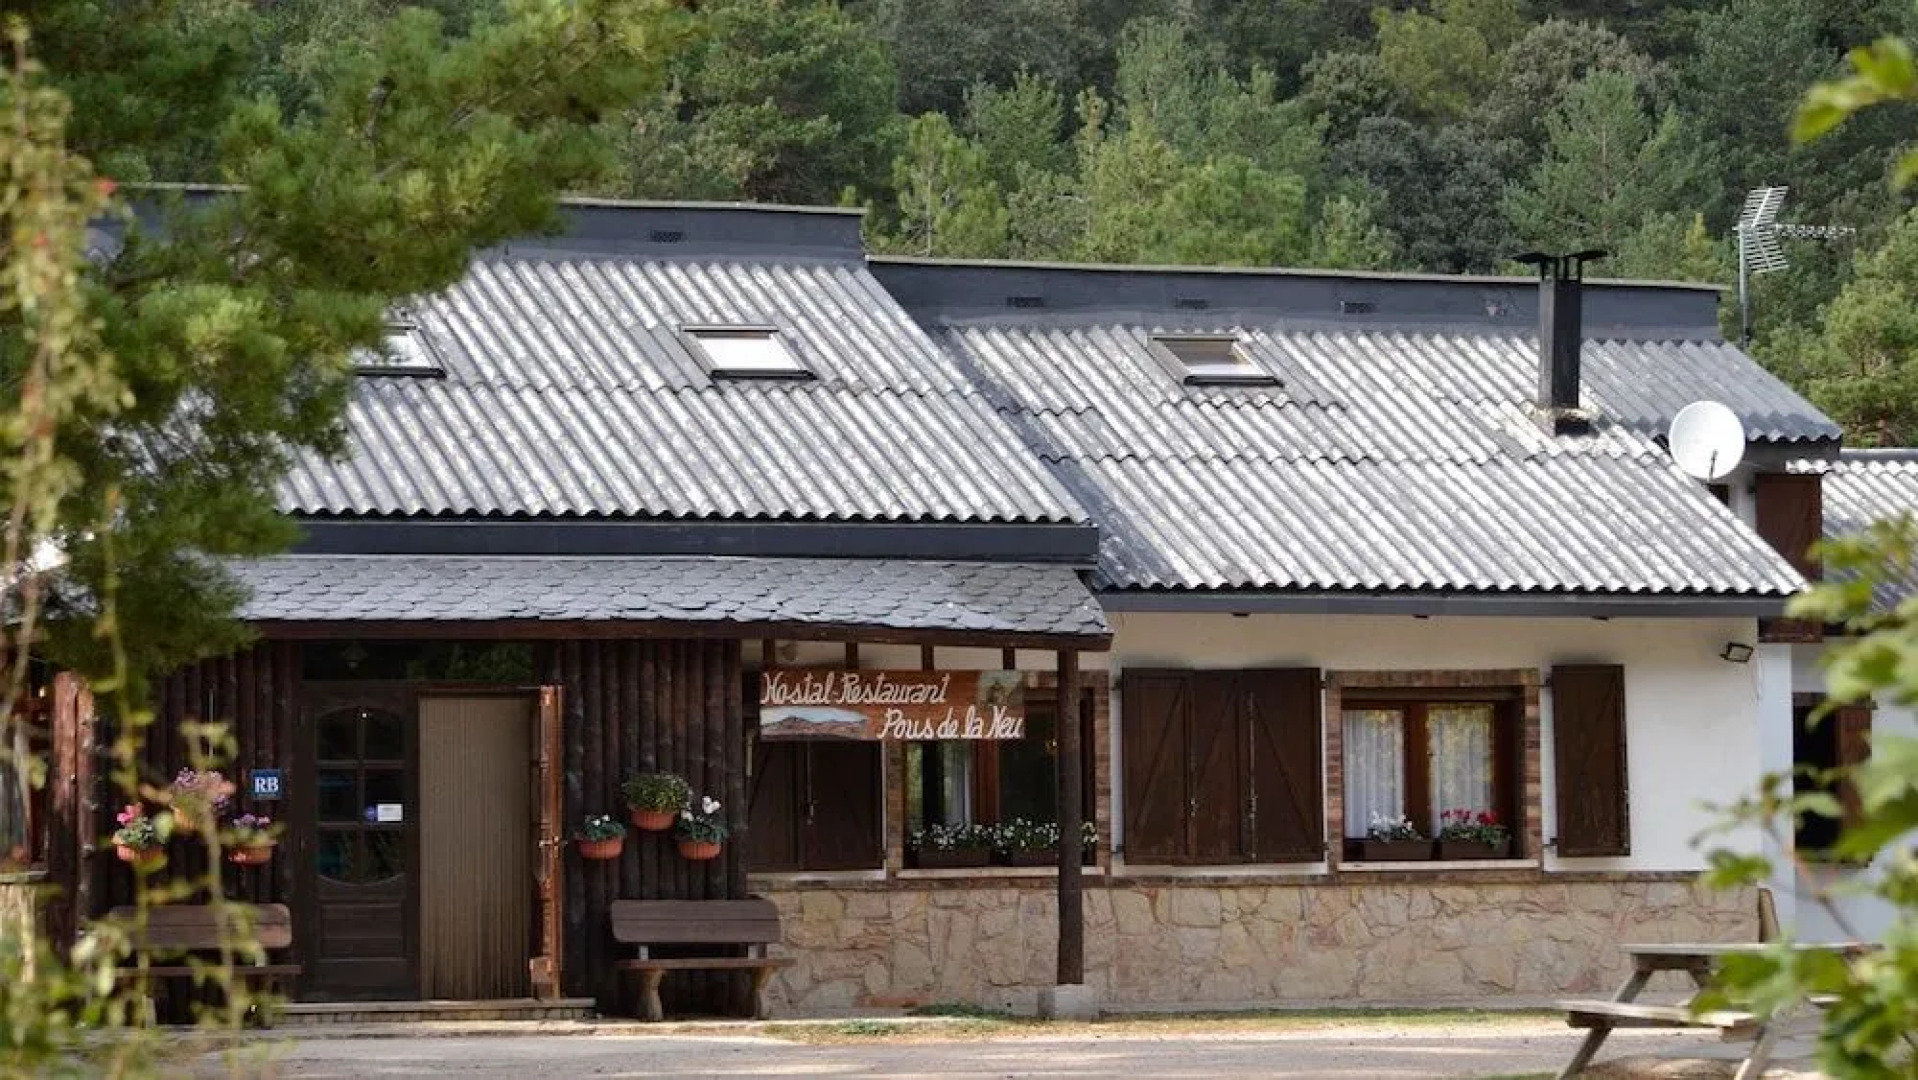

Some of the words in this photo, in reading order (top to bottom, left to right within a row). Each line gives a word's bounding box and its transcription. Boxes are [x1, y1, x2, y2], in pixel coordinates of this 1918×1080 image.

[877, 708, 933, 739] Pous
[937, 707, 958, 738] de
[961, 705, 982, 738] la
[985, 704, 1023, 738] Neu
[254, 776, 279, 793] RB
